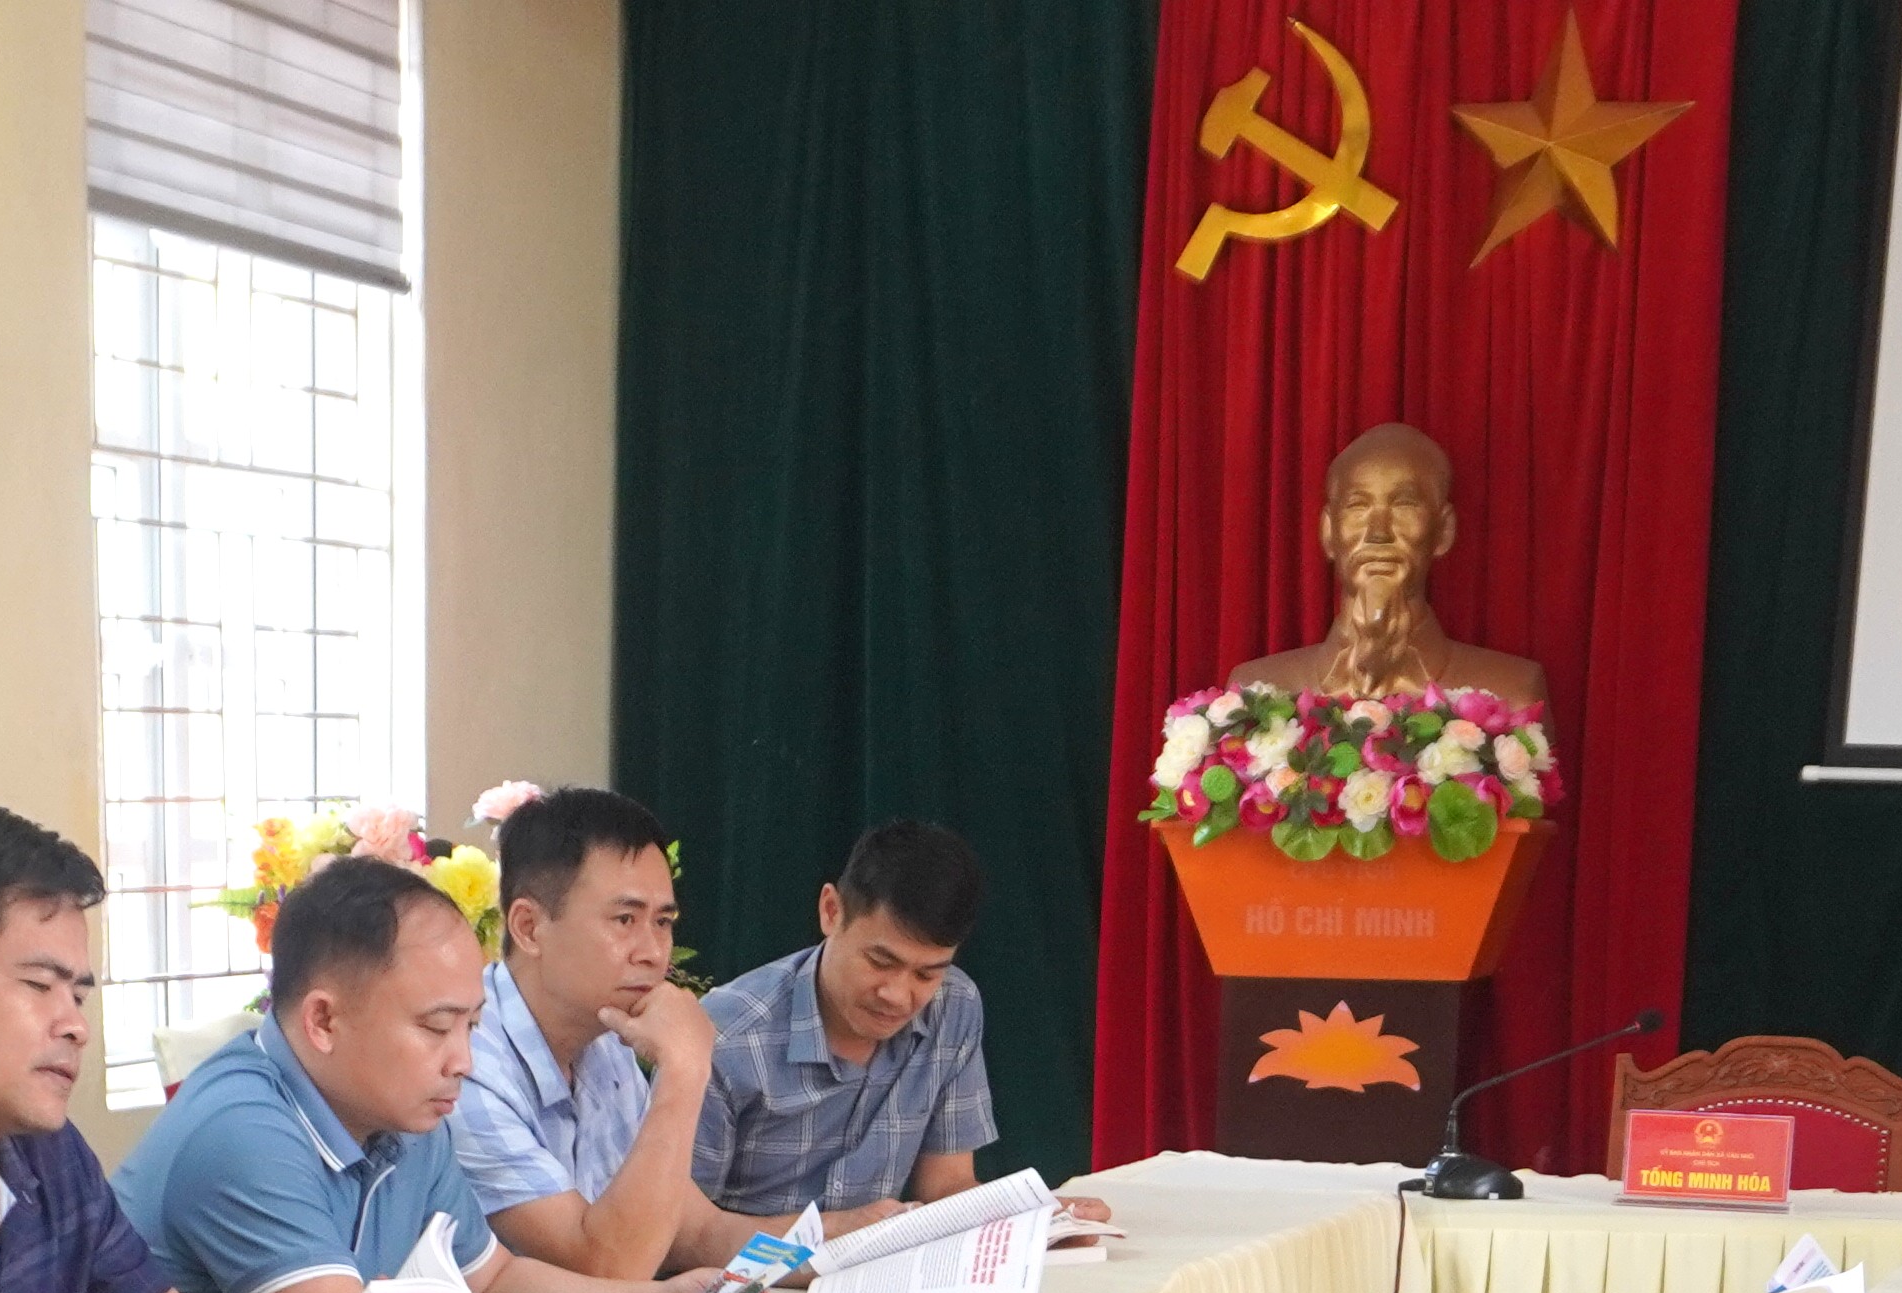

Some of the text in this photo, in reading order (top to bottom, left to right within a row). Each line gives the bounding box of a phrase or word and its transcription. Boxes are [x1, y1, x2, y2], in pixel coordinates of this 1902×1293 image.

[1246, 897, 1435, 937] HỒ CHÍ MINH
[1640, 1165, 1771, 1192] TỐNG MINH HÓA
